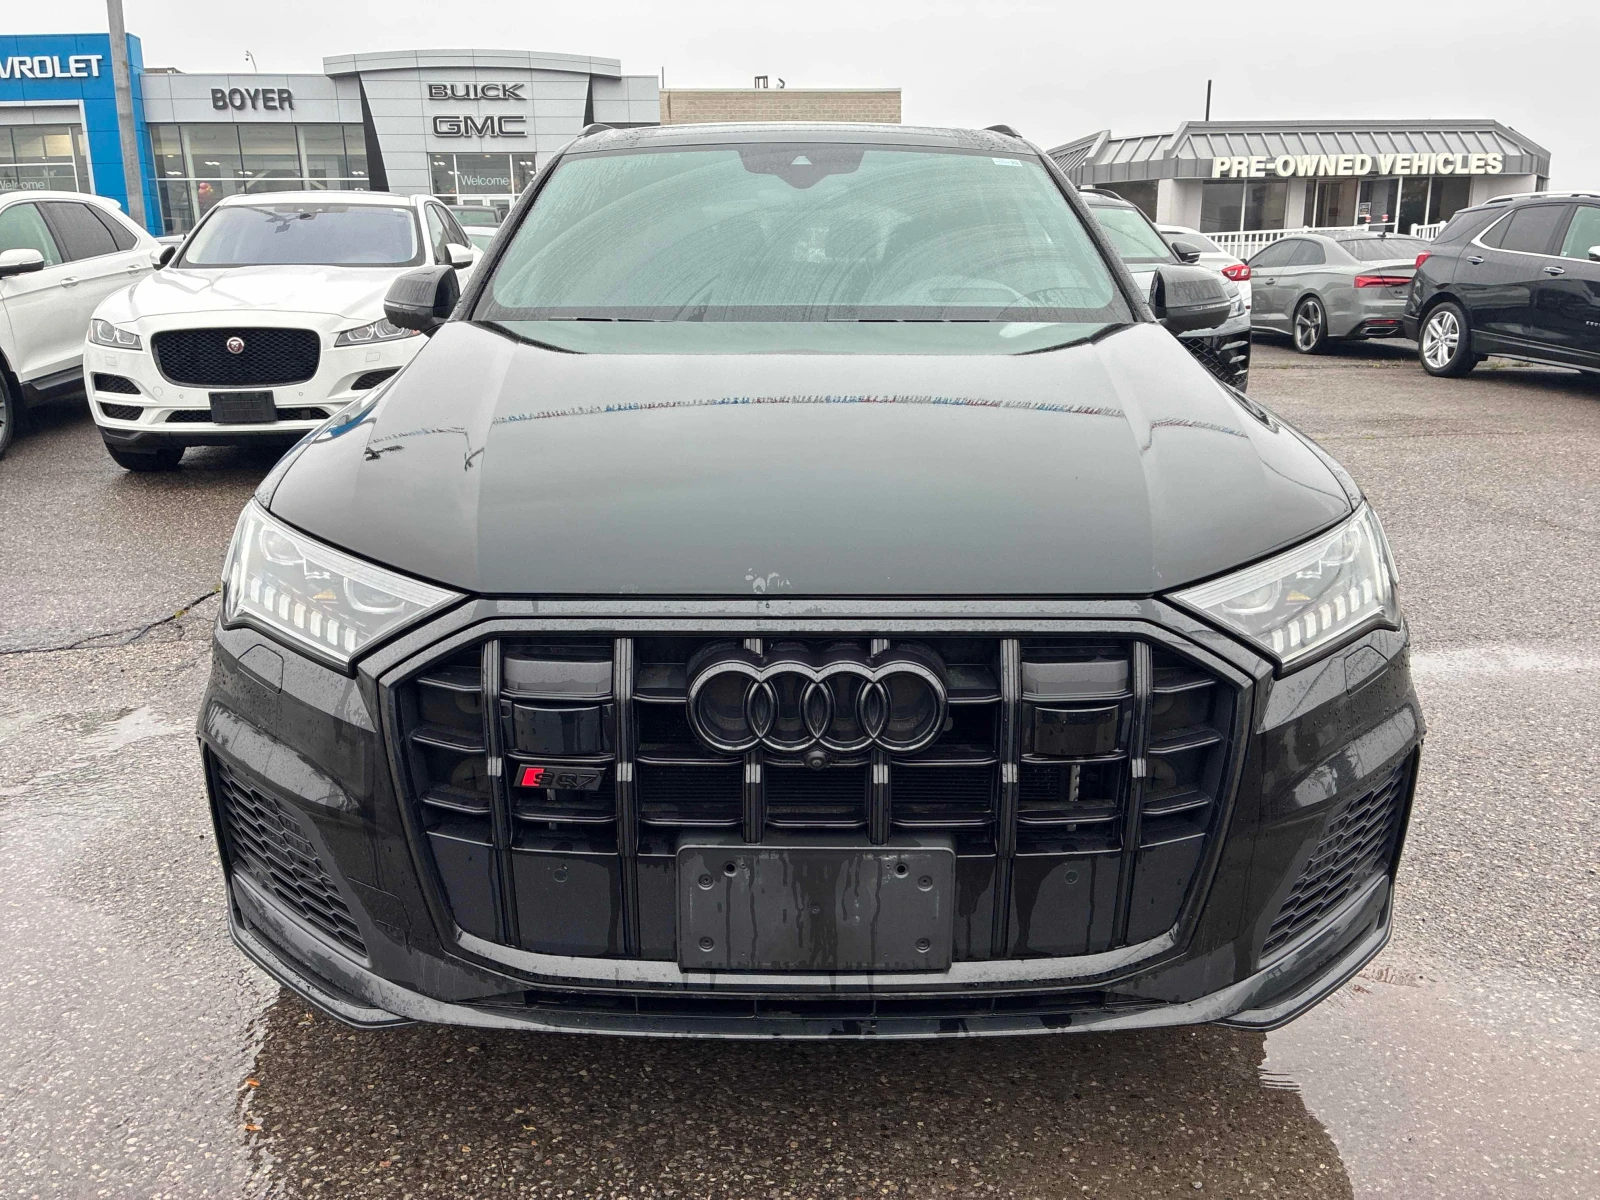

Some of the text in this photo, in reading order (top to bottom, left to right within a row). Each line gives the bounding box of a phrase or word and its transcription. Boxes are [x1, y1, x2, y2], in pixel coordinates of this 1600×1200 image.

[0, 54, 103, 78] VROLET
[210, 87, 295, 111] BOYER
[427, 82, 526, 100] BUICK
[432, 114, 528, 137] GMC
[1212, 152, 1503, 178] PRE-OWNED VEHICLES
[461, 175, 509, 187] Welcome
